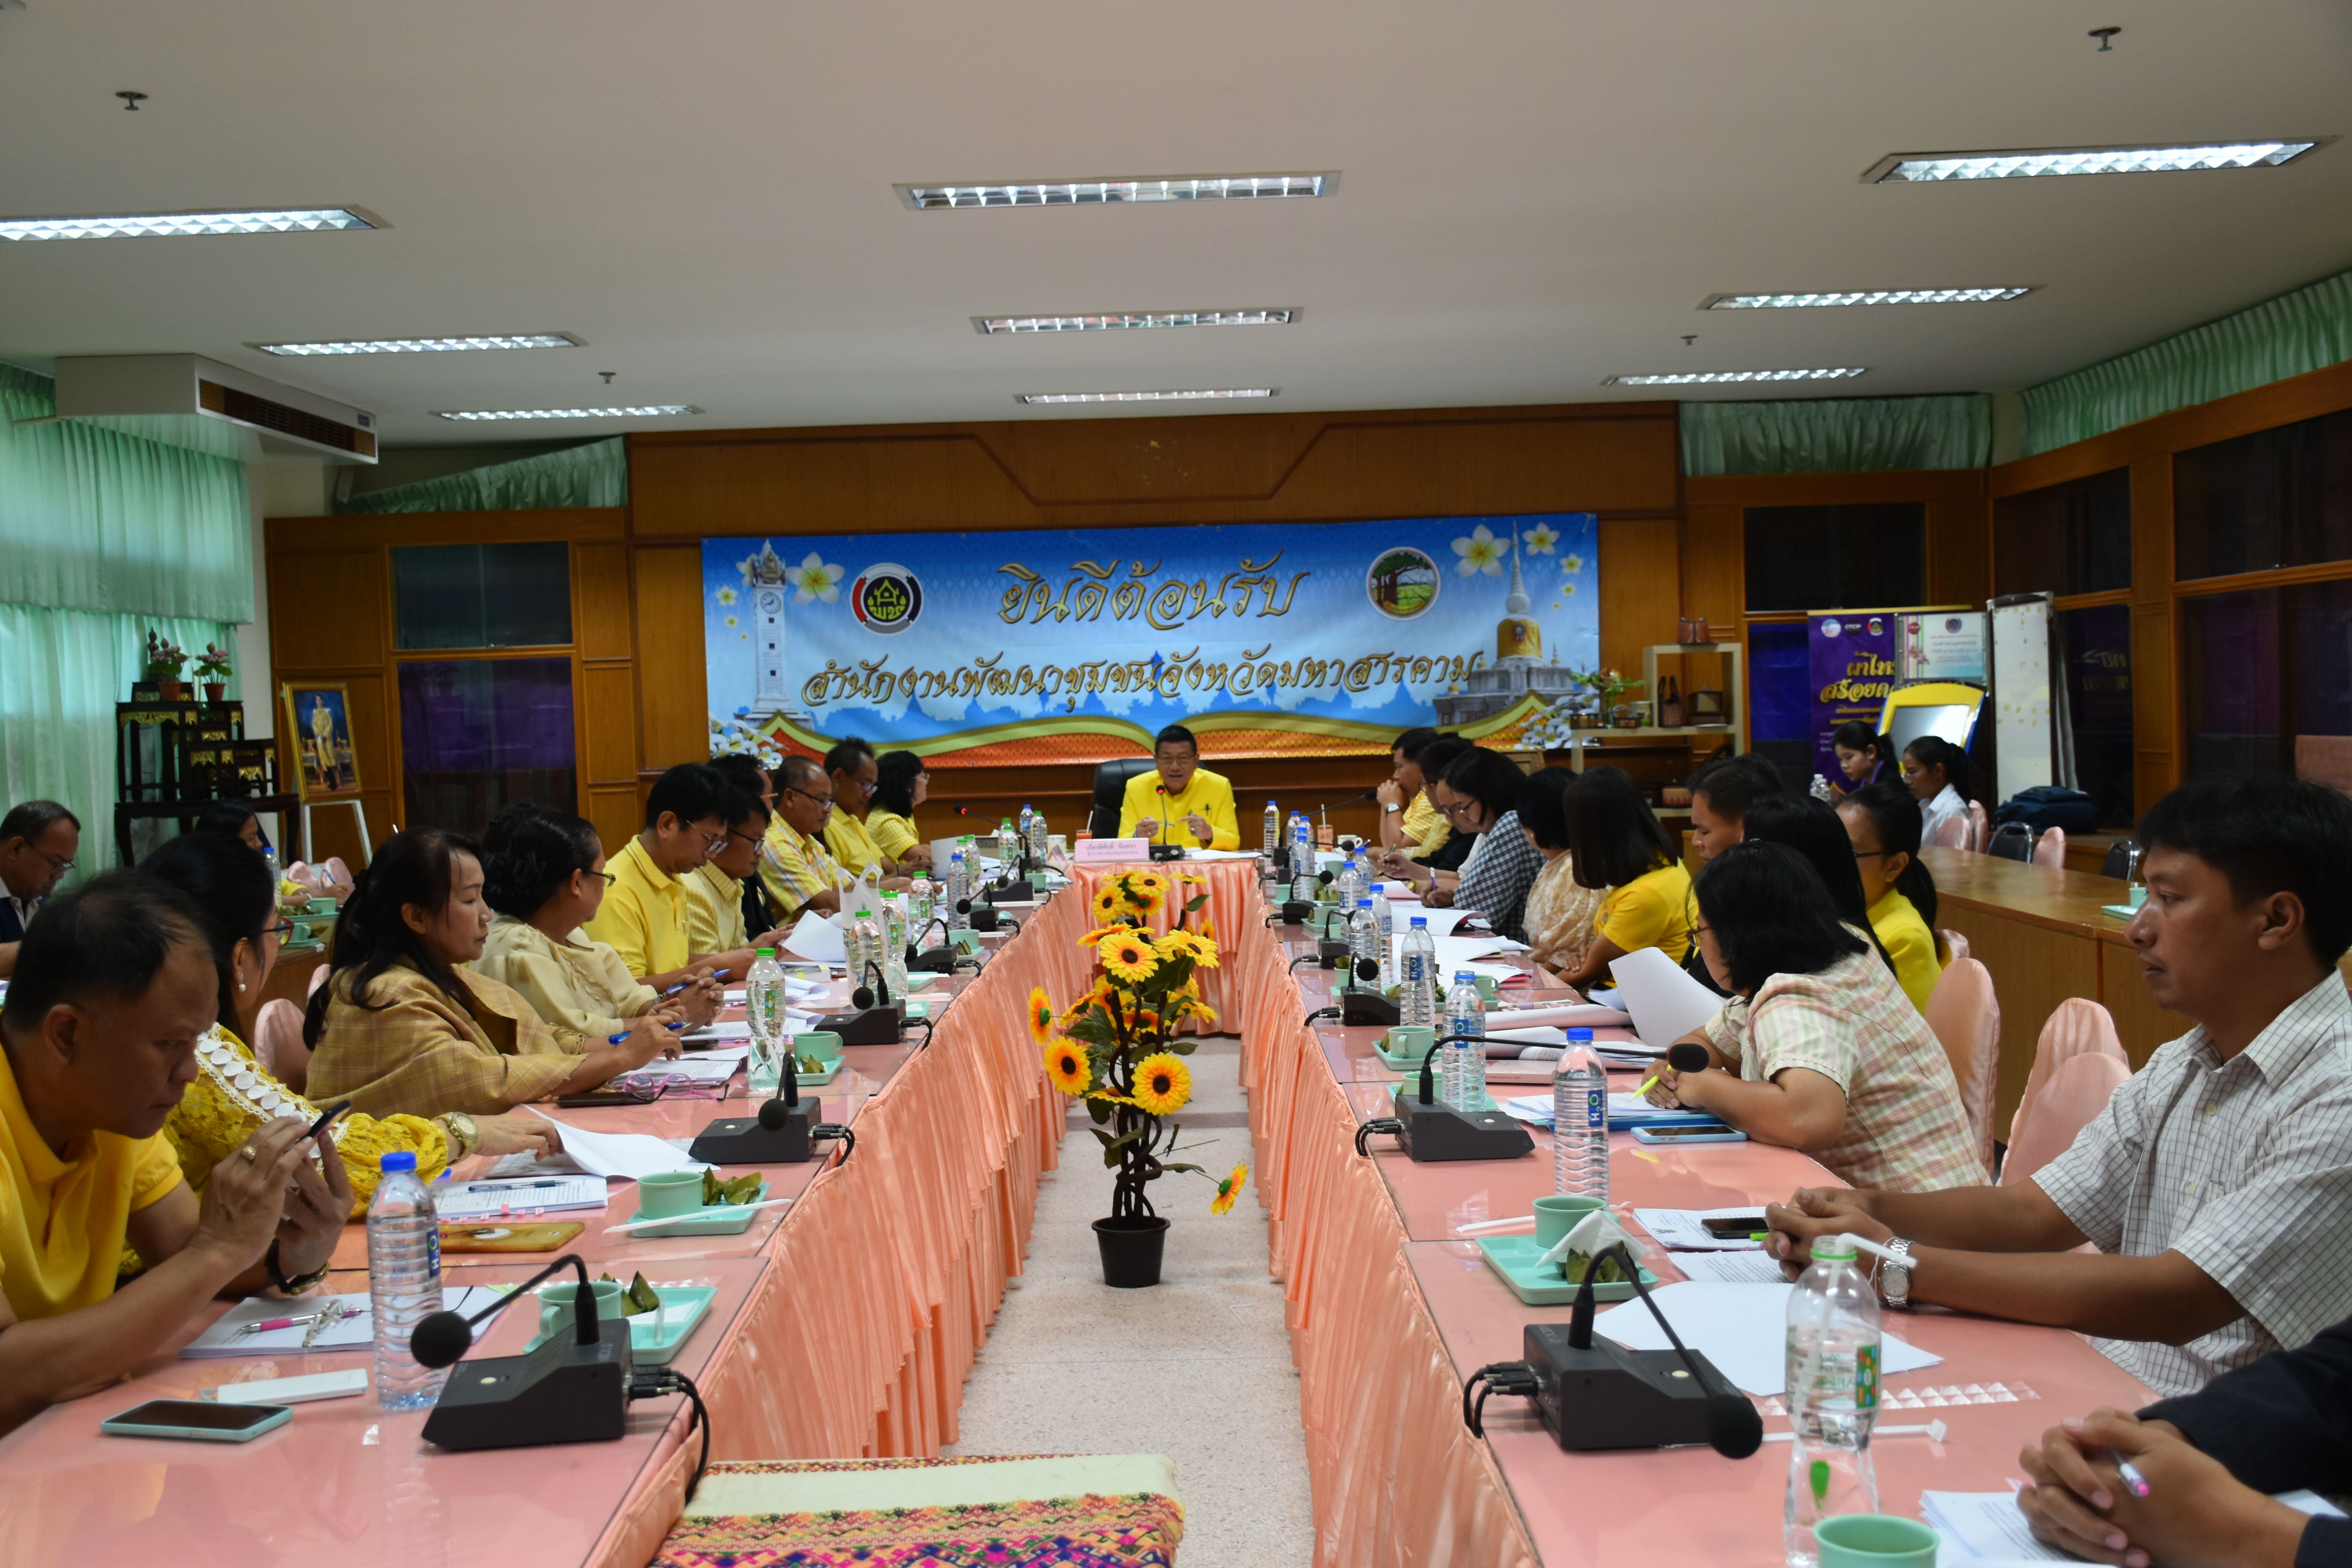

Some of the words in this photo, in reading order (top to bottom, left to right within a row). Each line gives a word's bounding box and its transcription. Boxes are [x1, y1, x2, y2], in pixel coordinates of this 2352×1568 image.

[997, 548, 1310, 630] ยินดีต้อนรับ
[1847, 650, 1895, 676] ผ้าไห
[1410, 959, 1420, 977] H2O
[1589, 1094, 1602, 1121] H2O
